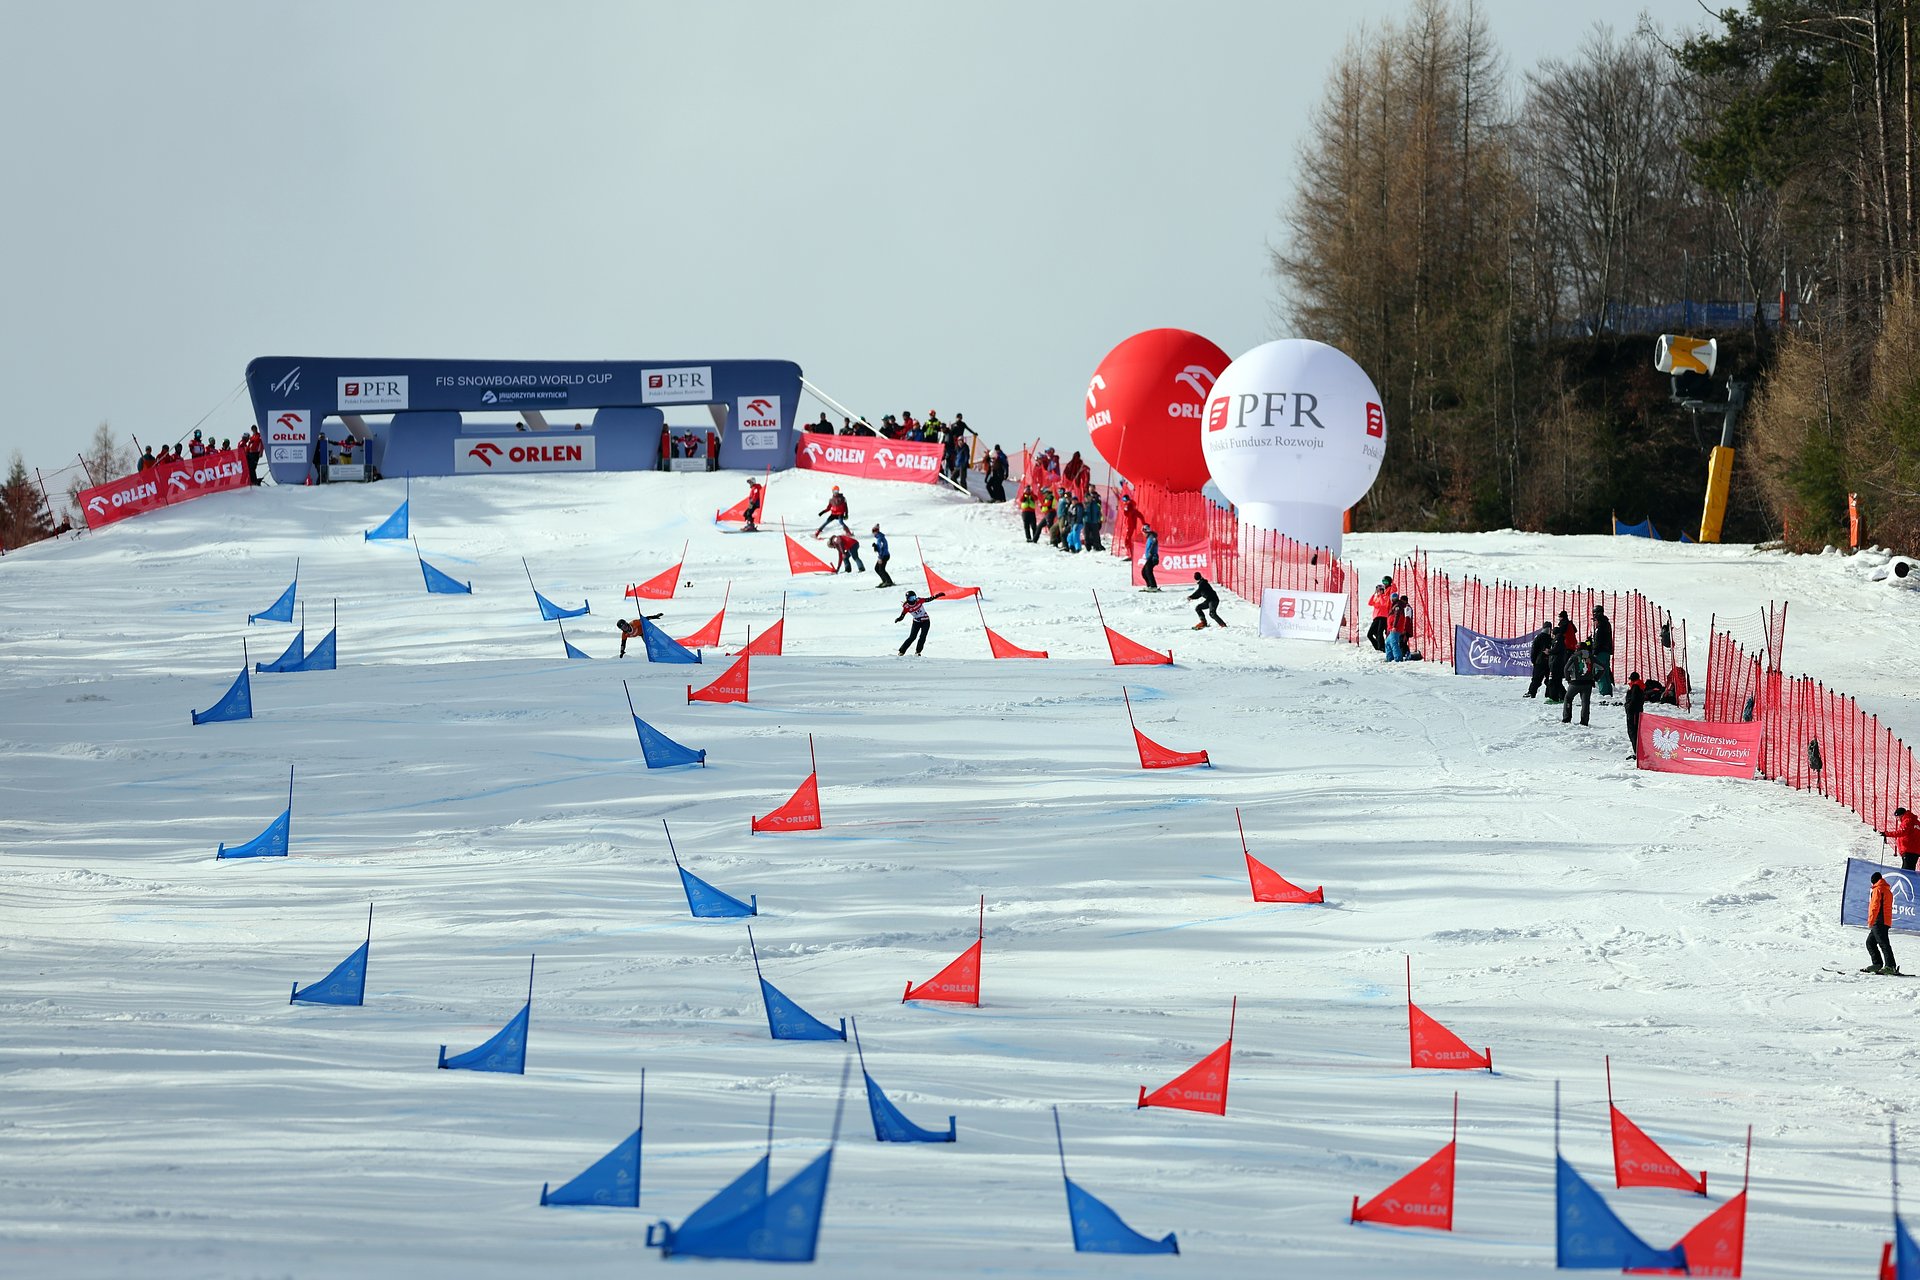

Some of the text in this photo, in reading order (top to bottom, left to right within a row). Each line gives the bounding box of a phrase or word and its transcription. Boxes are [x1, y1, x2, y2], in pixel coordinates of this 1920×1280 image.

[436, 373, 613, 386] FIS SNOWBOARD WORLD CUP
[667, 373, 704, 388] PFR
[363, 381, 401, 396] PFR
[1168, 402, 1203, 419] ORL
[1235, 392, 1325, 429] PFR
[743, 419, 776, 427] ORLEN
[273, 433, 306, 441] ORLEN
[1230, 436, 1273, 449] Fundusz
[1275, 436, 1324, 450] Rozwoju
[508, 445, 582, 463] ORLEN
[825, 447, 865, 464] ORLEN
[896, 453, 938, 471] ORLEN
[194, 460, 243, 484] ORLEN
[112, 481, 158, 507] ORLEN
[1162, 553, 1207, 571] ORLEN
[1300, 598, 1335, 621] PFR
[1682, 732, 1738, 746] Ministerstwo
[1715, 748, 1751, 759] Turystyki
[786, 815, 815, 823] ORLEN
[941, 984, 975, 993] ORLEN
[1434, 1051, 1470, 1060] ORLEN
[1184, 1090, 1221, 1101] ORLEN
[1641, 1163, 1681, 1176] ORLEN
[1403, 1203, 1447, 1216] ORLEN
